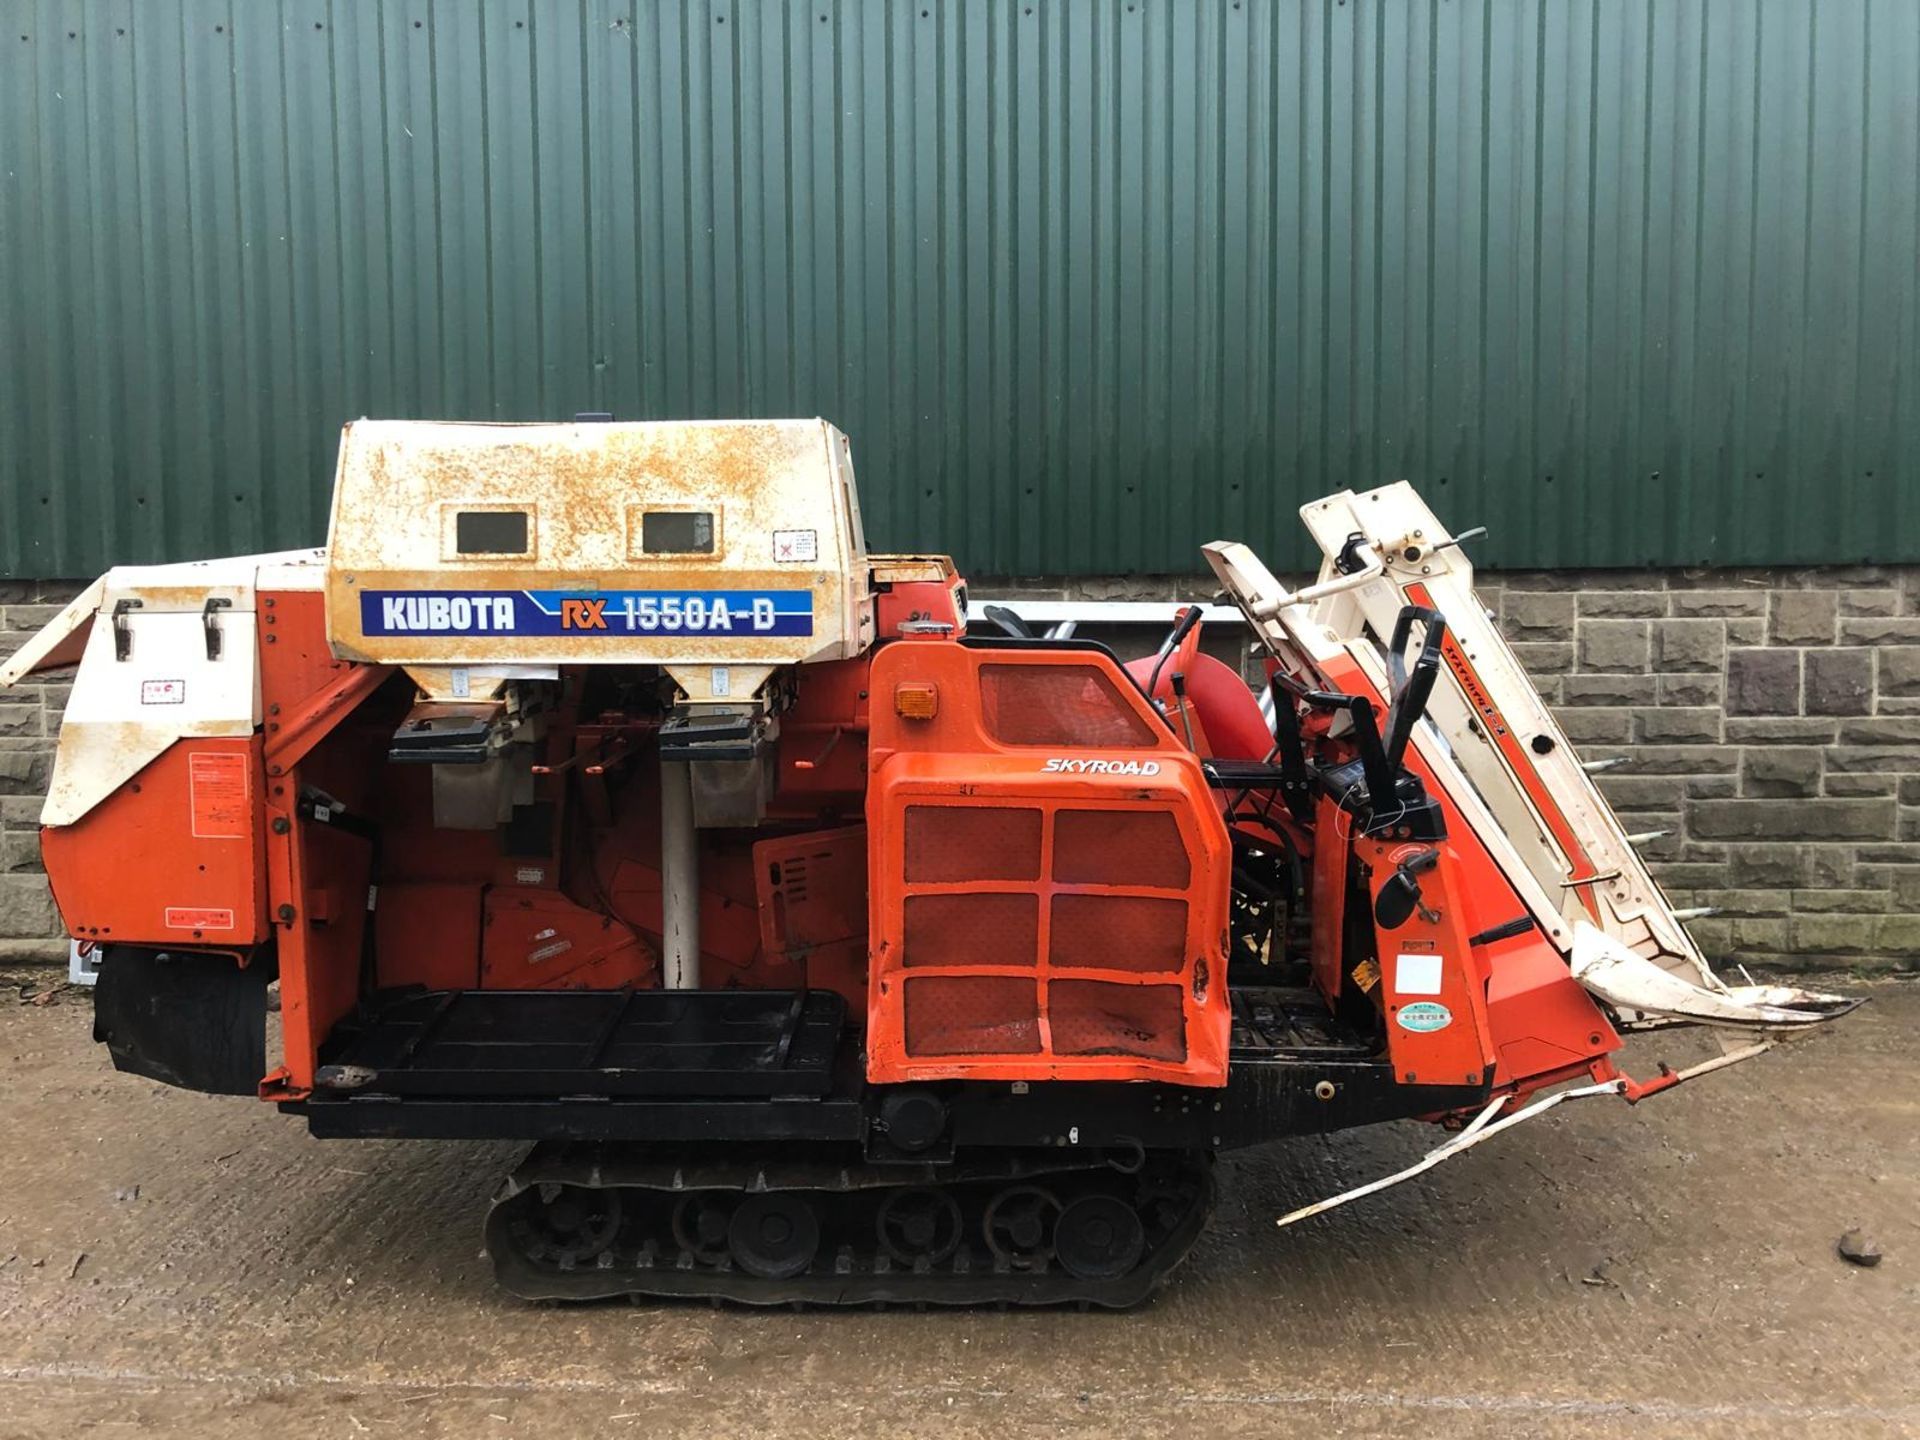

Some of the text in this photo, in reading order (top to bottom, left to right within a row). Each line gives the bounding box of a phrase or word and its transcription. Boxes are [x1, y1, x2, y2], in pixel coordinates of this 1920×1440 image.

[382, 597, 776, 630] KUBOTA RX 1550A-D
[1041, 759, 1160, 776] SKYROAD
